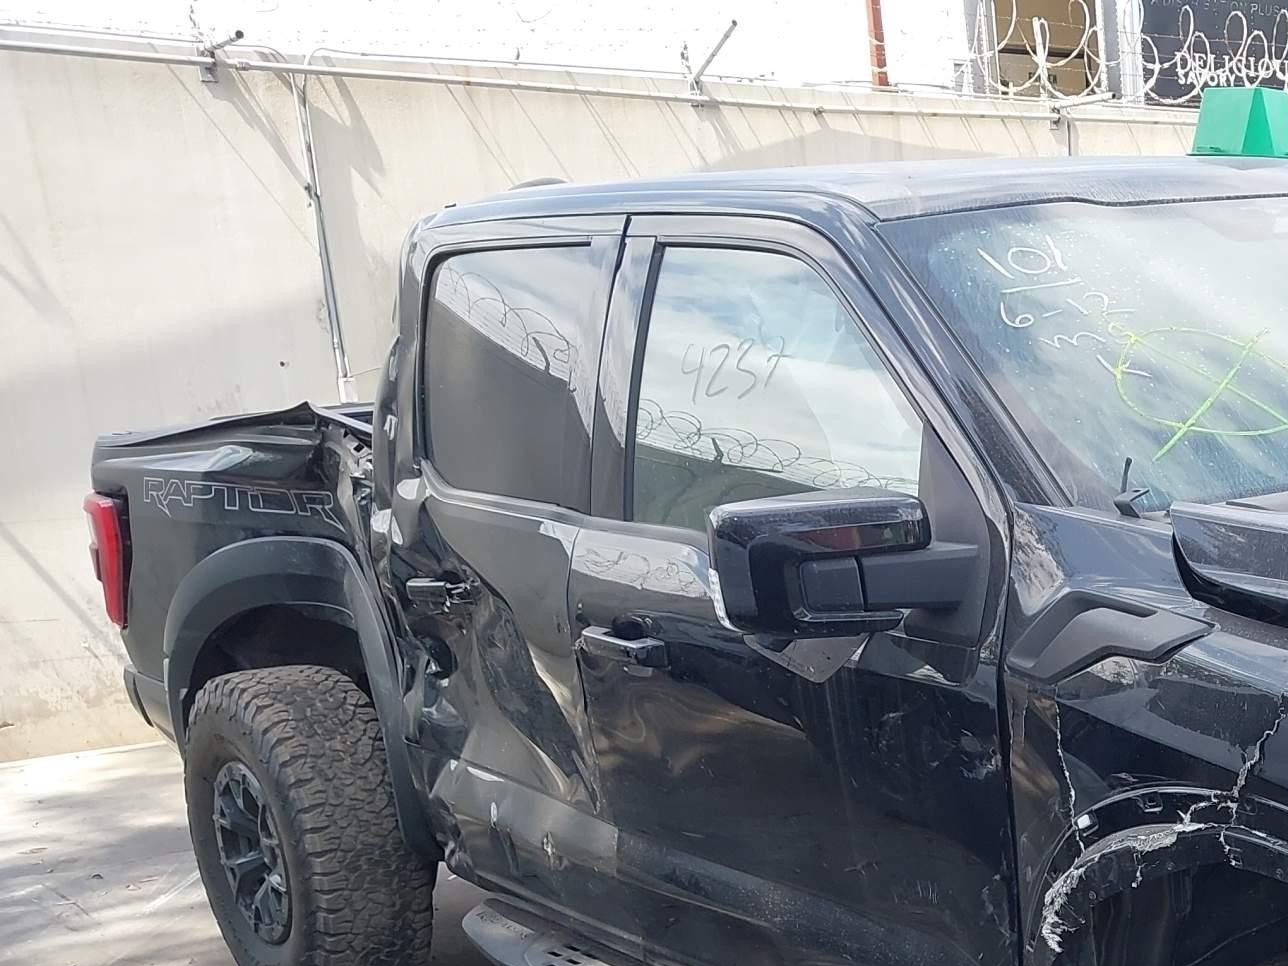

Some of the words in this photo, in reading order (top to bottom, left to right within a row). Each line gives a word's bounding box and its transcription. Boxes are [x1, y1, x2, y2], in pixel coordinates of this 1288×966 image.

[1177, 70, 1236, 87] SAVORY
[976, 234, 1068, 280] 101
[143, 476, 347, 534] RAPTOR
